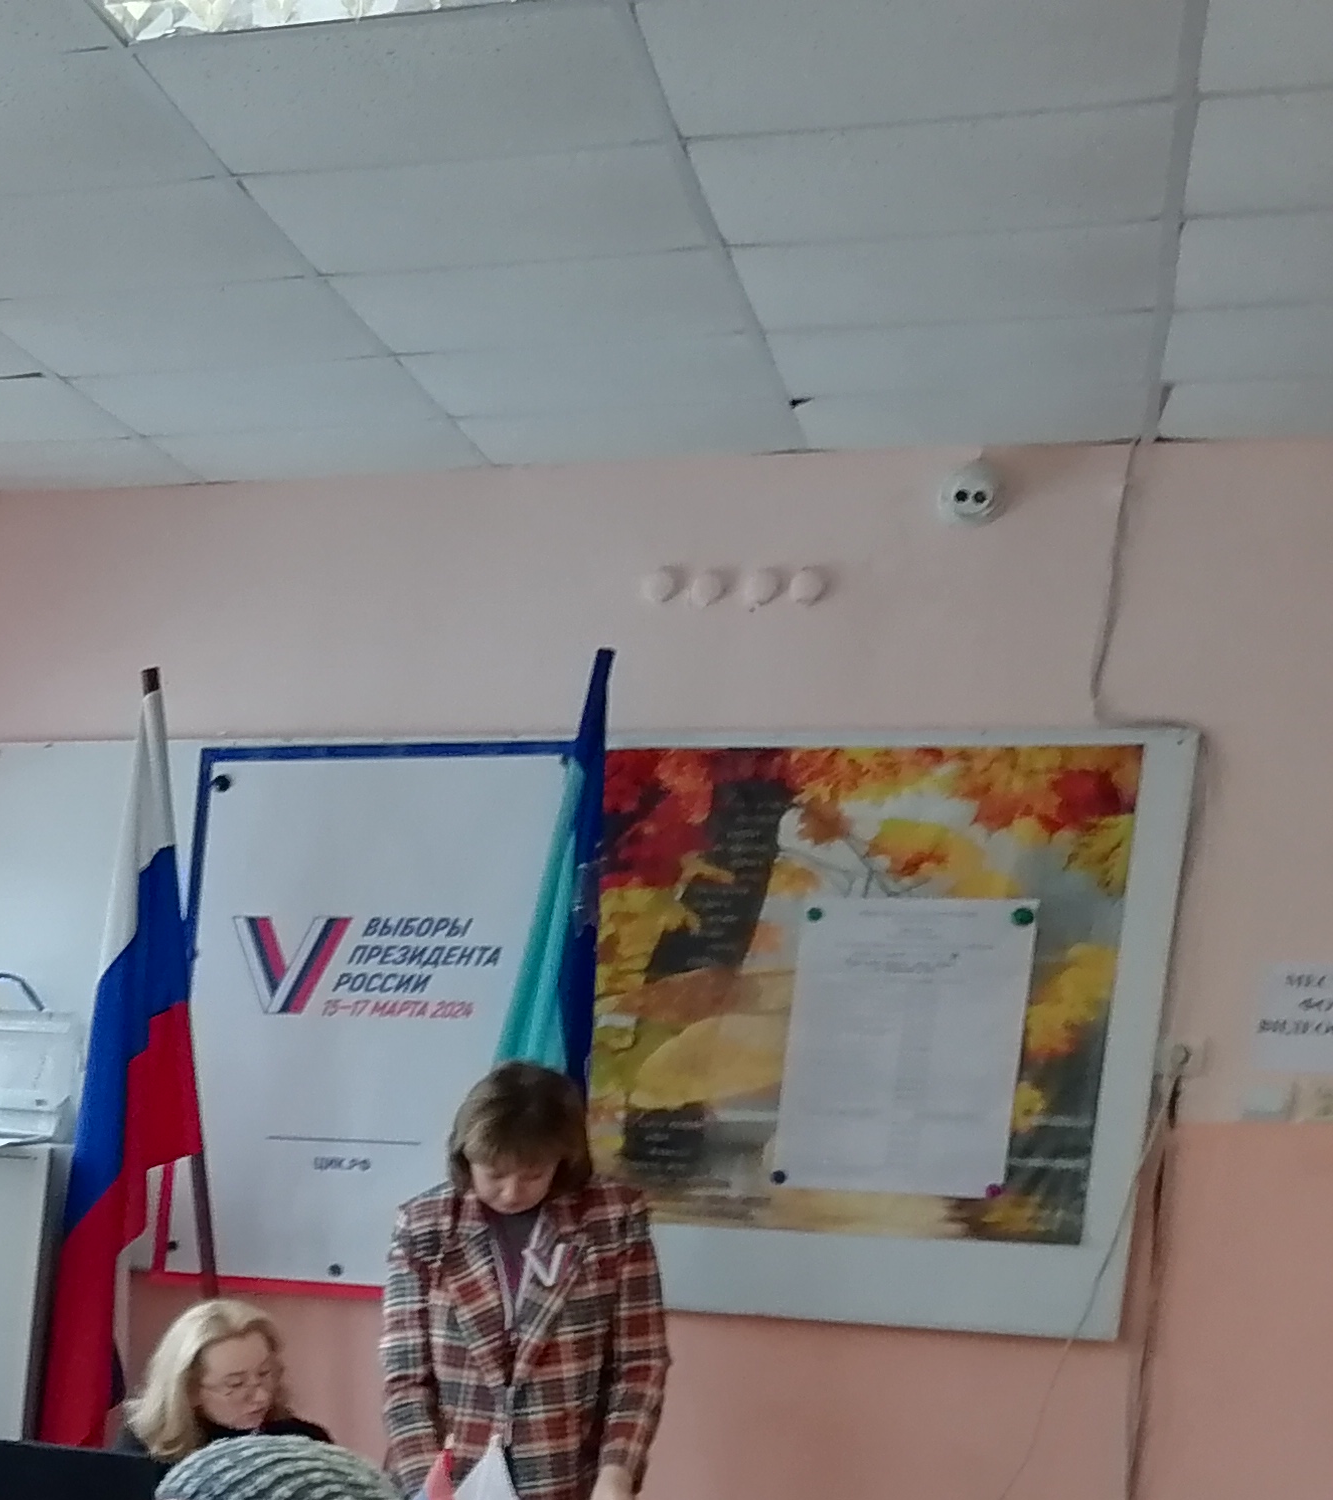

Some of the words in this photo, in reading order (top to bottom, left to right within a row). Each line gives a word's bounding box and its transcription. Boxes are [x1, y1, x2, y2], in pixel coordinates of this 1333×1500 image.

[362, 916, 474, 938] ВЫБОРЫ
[347, 944, 503, 969] ПРЕЗИДЕНТА
[332, 972, 432, 993] РОССИИ
[369, 1000, 430, 1019] МАРТА
[429, 1000, 474, 1019] 2024
